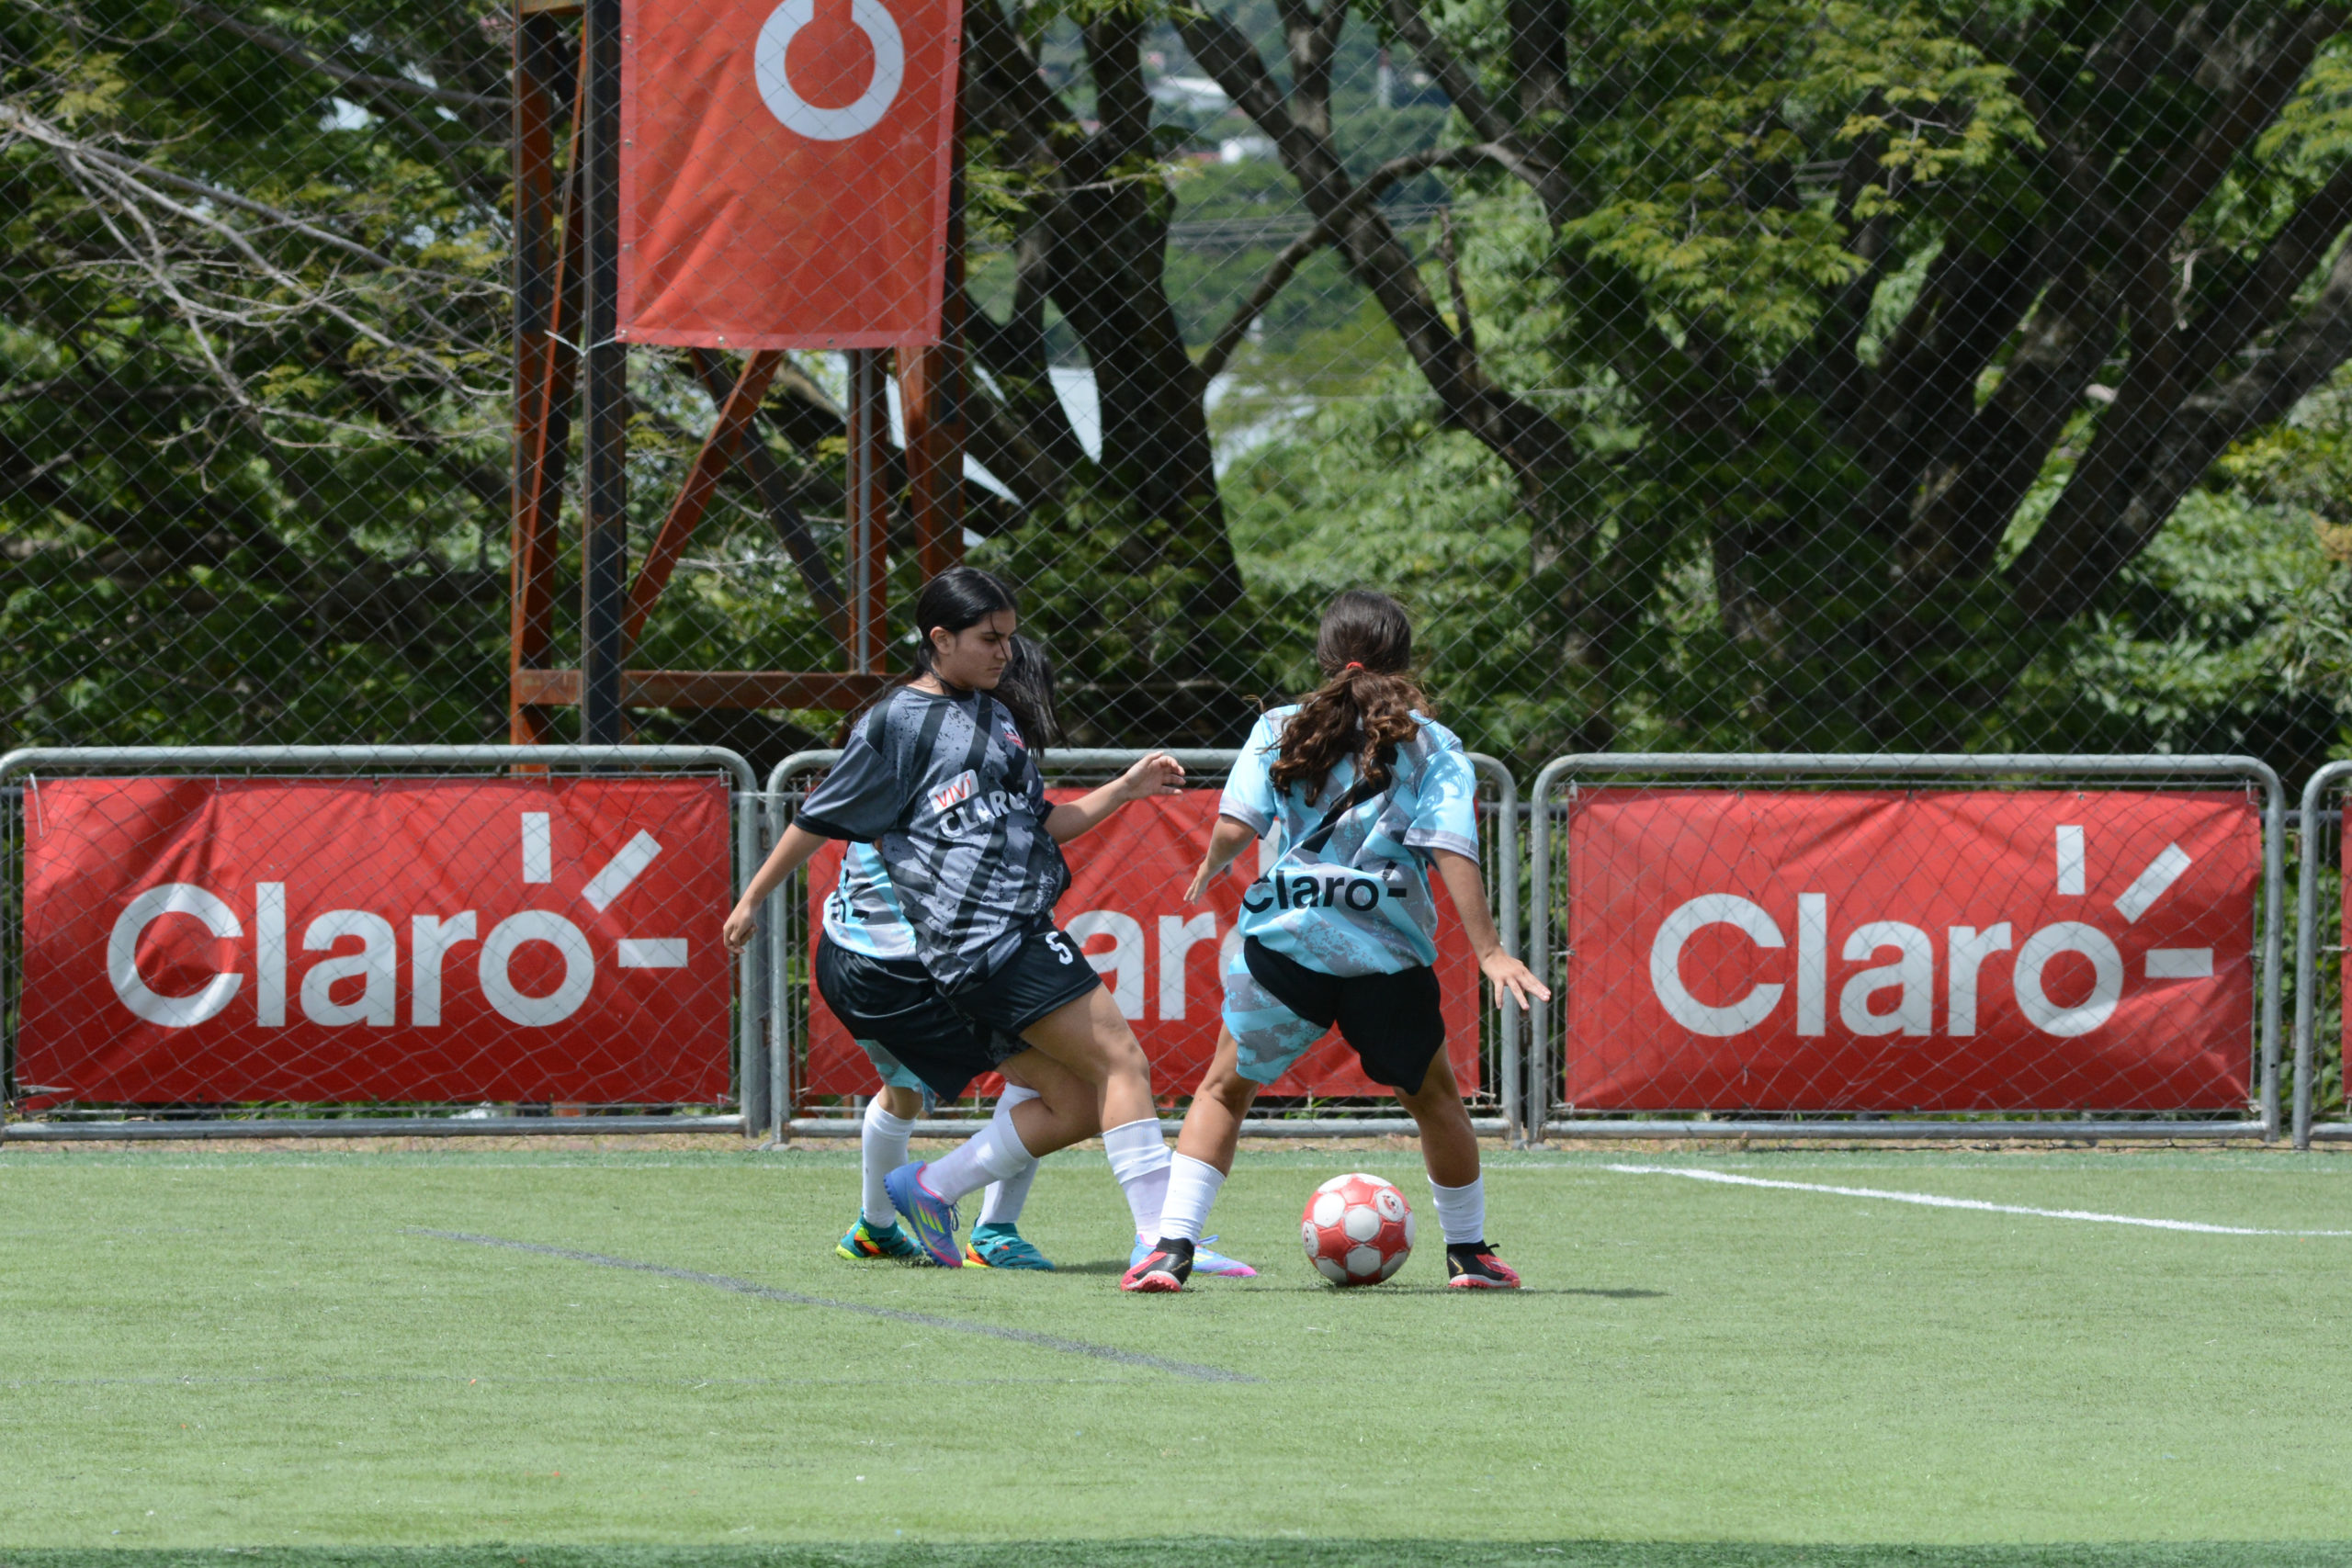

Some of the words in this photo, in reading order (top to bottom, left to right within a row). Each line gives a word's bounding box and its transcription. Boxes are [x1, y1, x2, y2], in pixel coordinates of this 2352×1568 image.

[1242, 869, 1379, 914] Claro
[107, 883, 595, 1027] Claro
[1045, 931, 1074, 965] 5
[1650, 893, 2124, 1038] Claro
